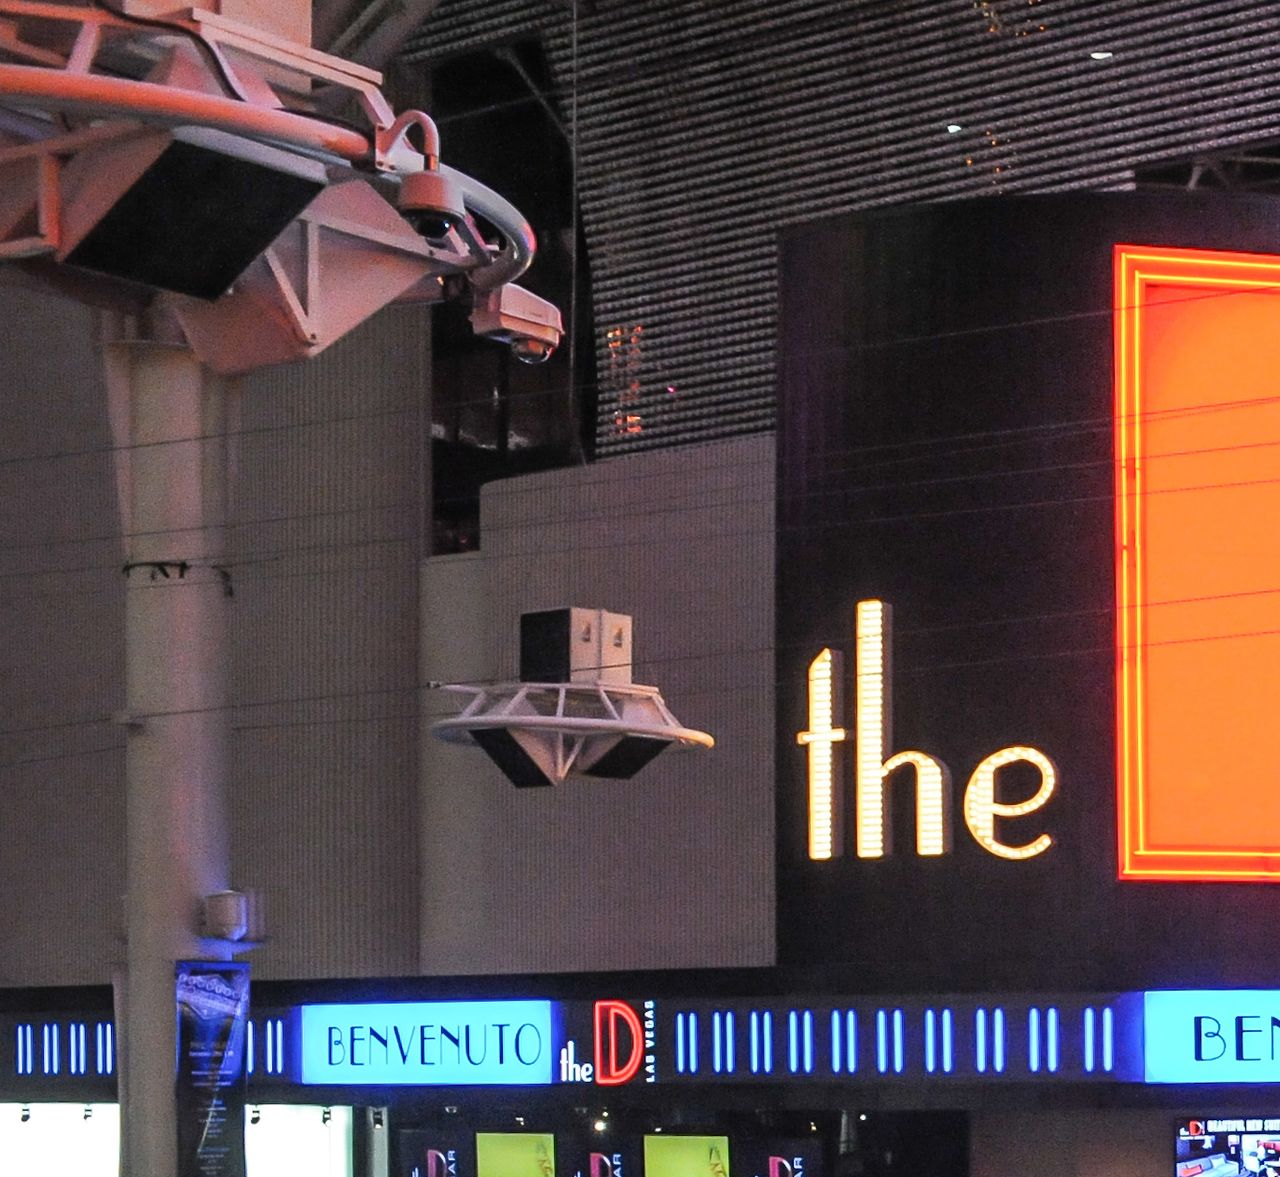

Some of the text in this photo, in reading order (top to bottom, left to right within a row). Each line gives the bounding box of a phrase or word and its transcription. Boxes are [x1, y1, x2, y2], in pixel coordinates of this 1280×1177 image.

[797, 598, 1058, 861] the
[327, 1022, 542, 1066] BENVENUTO
[559, 999, 643, 1086] the D
